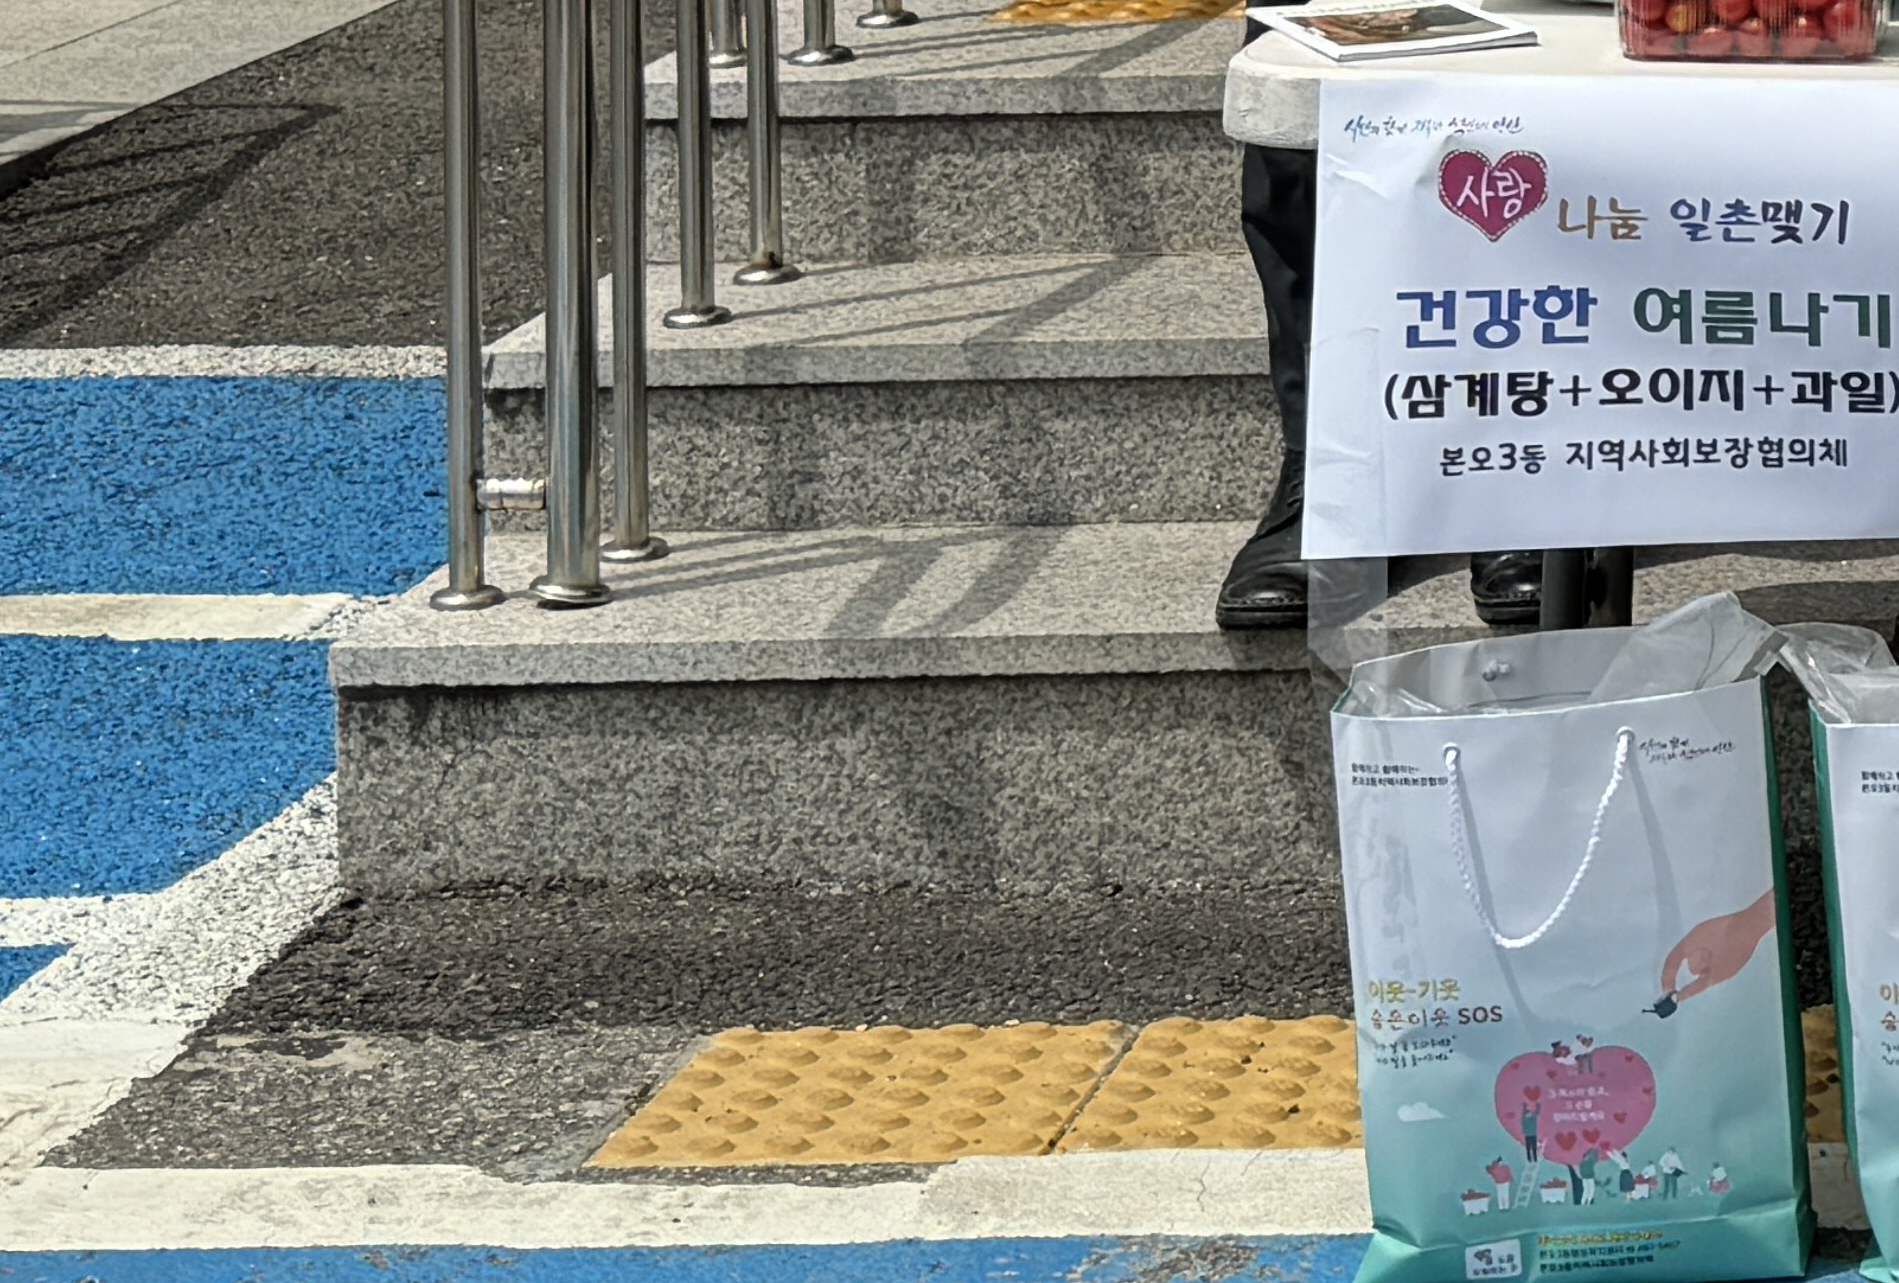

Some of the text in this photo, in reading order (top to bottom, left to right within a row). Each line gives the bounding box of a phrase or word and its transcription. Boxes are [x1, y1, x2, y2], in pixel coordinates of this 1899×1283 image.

[1456, 165, 1850, 245] 사랑 나눔 일촌맺기
[1396, 284, 1891, 349] 건강한 여름나기
[1439, 436, 1848, 477] 본오3동 지역사회보장협의체
[1458, 1005, 1503, 1026] SOS
